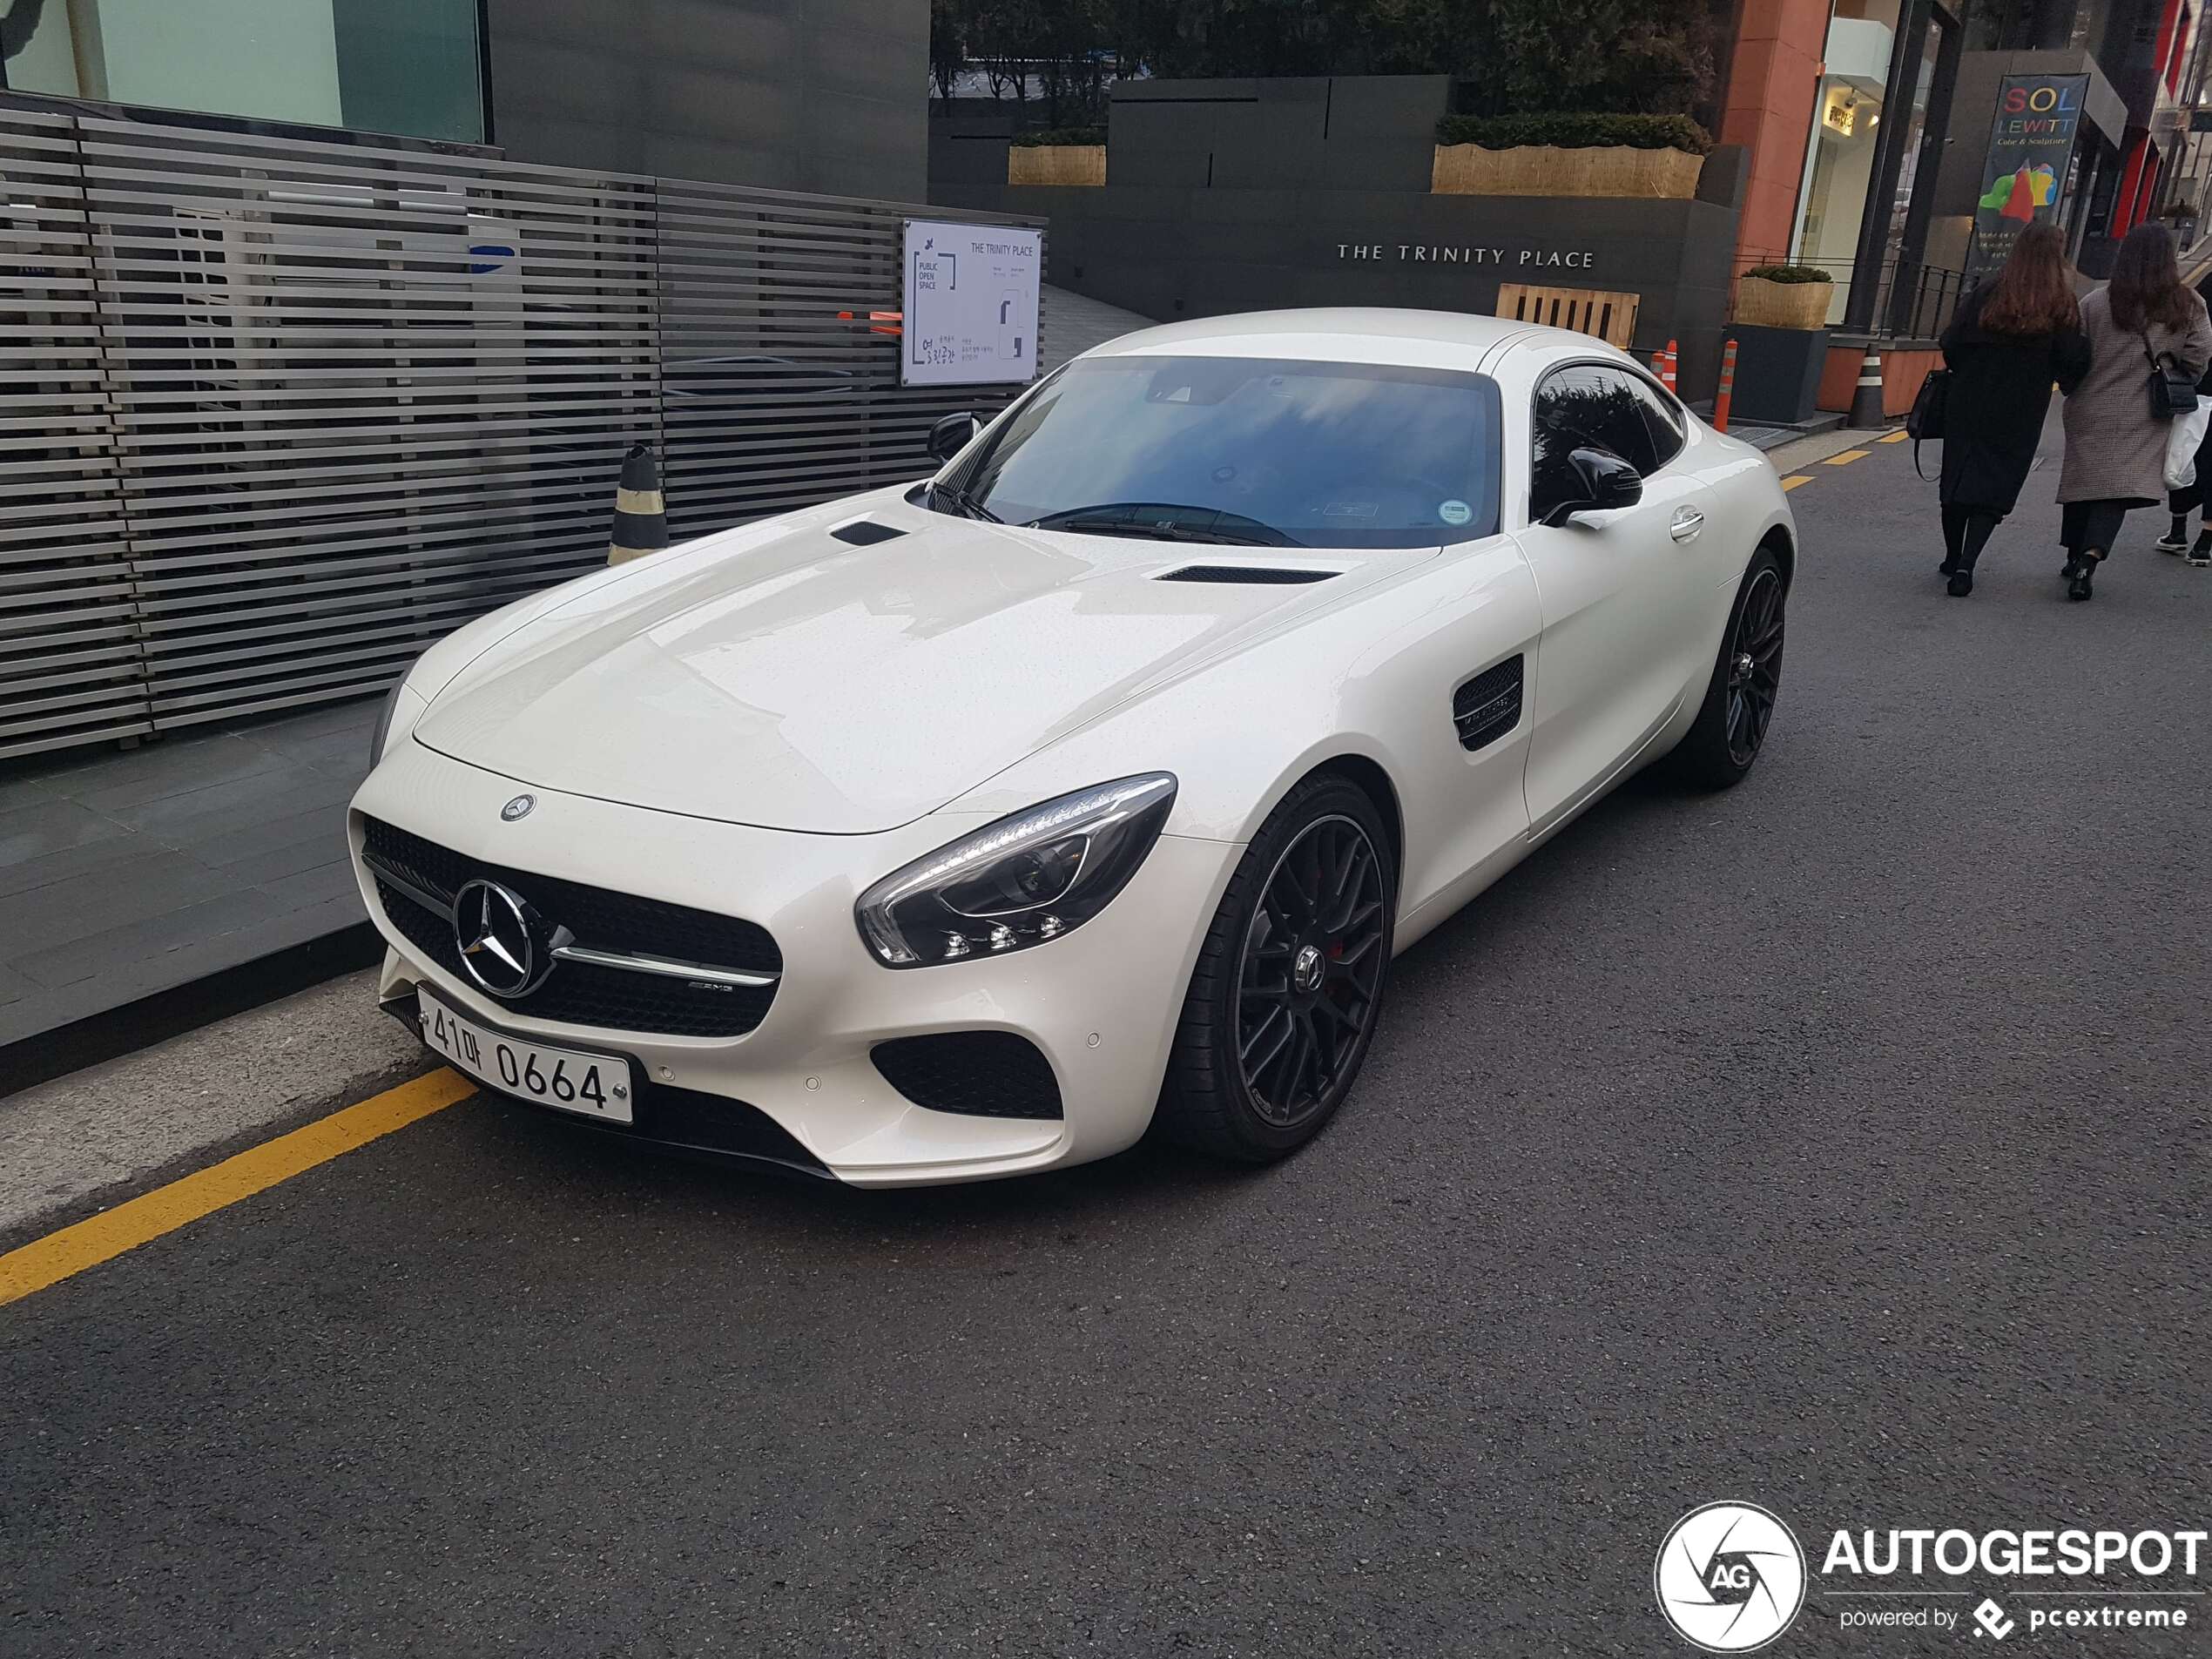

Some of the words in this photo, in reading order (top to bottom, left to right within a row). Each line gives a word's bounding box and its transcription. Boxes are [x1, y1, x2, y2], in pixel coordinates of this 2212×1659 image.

[2004, 86, 2077, 112] SOL
[1998, 118, 2074, 133] LEWITT
[971, 242, 984, 254] THE
[986, 243, 1012, 256] TRINITY
[1013, 246, 1034, 257] PLACE
[1338, 245, 1383, 260] THE
[1399, 246, 1506, 264] TRINITY
[1520, 251, 1594, 268] PLACE
[919, 262, 939, 272] PUBLIC
[919, 272, 934, 280] OPEN
[919, 281, 936, 290] SPACE
[434, 1008, 482, 1071] 41마
[496, 1043, 607, 1109] 0664
